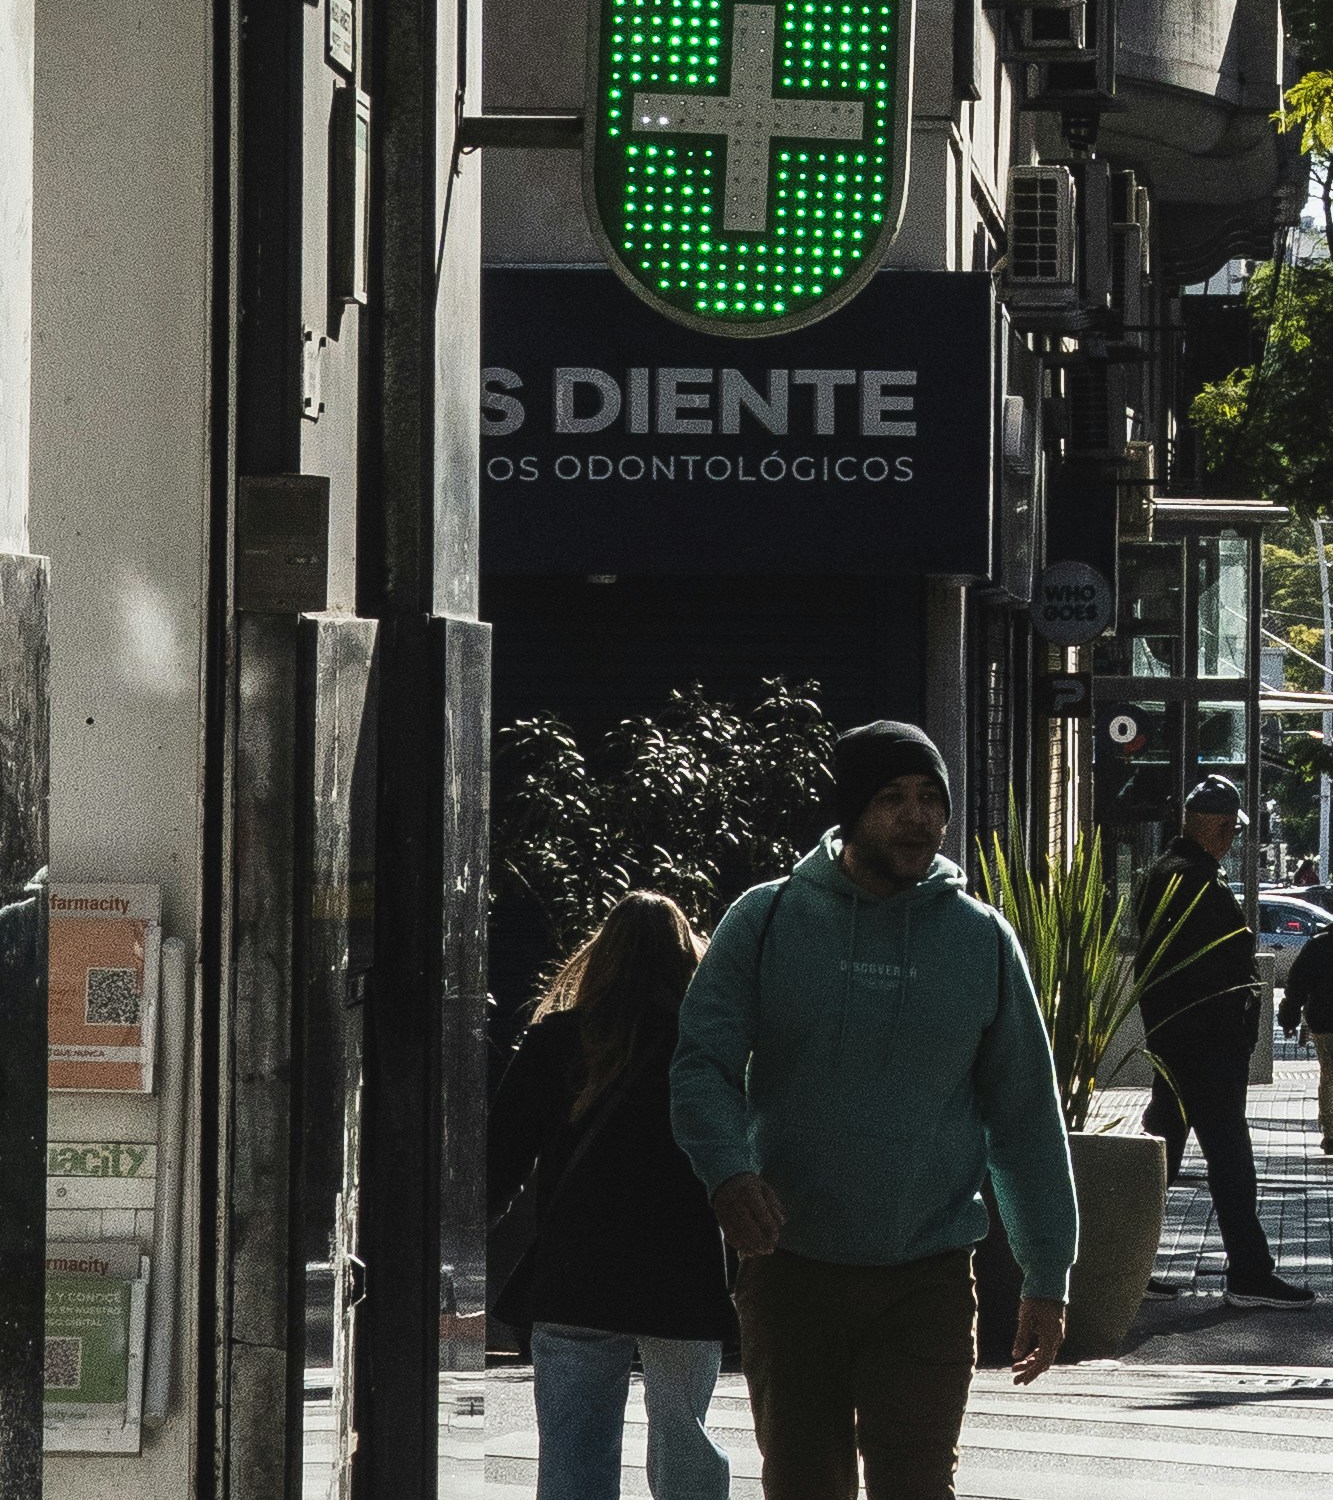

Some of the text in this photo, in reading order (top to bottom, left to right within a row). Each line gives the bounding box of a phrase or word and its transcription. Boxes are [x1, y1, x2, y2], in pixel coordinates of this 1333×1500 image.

[552, 366, 918, 437] DIENTE
[554, 450, 915, 482] ODONTOLÓGICOS
[1044, 584, 1096, 602] WHO
[1043, 604, 1098, 622] GOES
[50, 893, 130, 915] farmacity
[48, 1144, 148, 1178] acity
